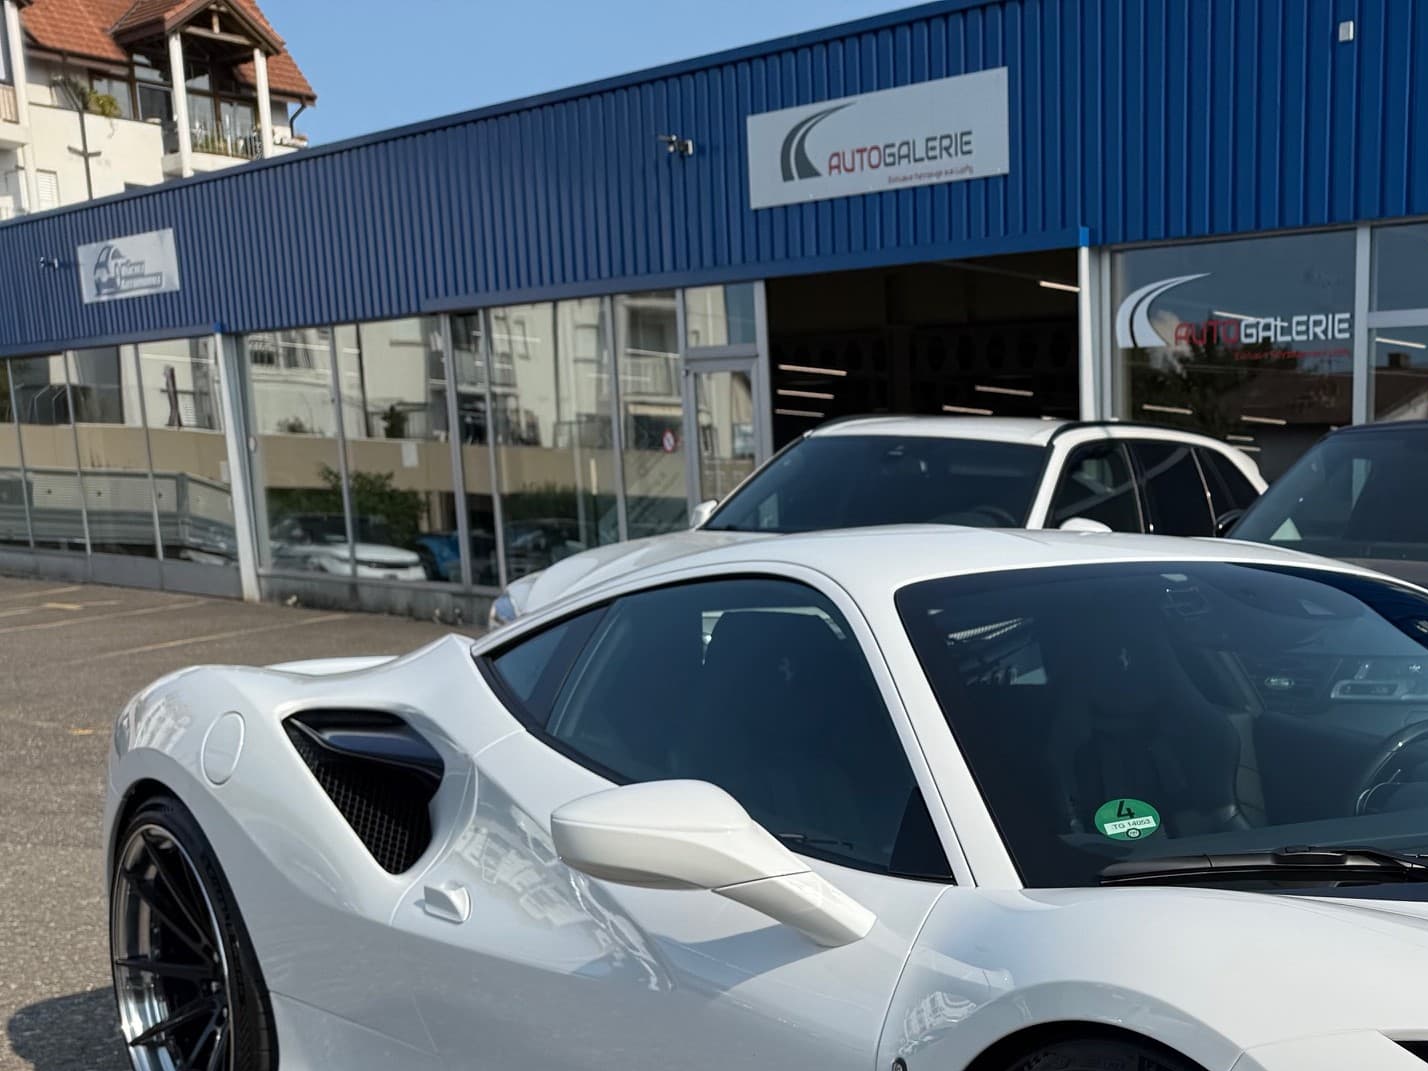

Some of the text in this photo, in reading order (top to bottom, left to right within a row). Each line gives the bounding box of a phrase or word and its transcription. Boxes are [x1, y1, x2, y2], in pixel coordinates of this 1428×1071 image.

[828, 130, 973, 176] AUTOGALERIE
[1174, 312, 1350, 346] AUTOGALERIE
[1116, 799, 1135, 818] 4
